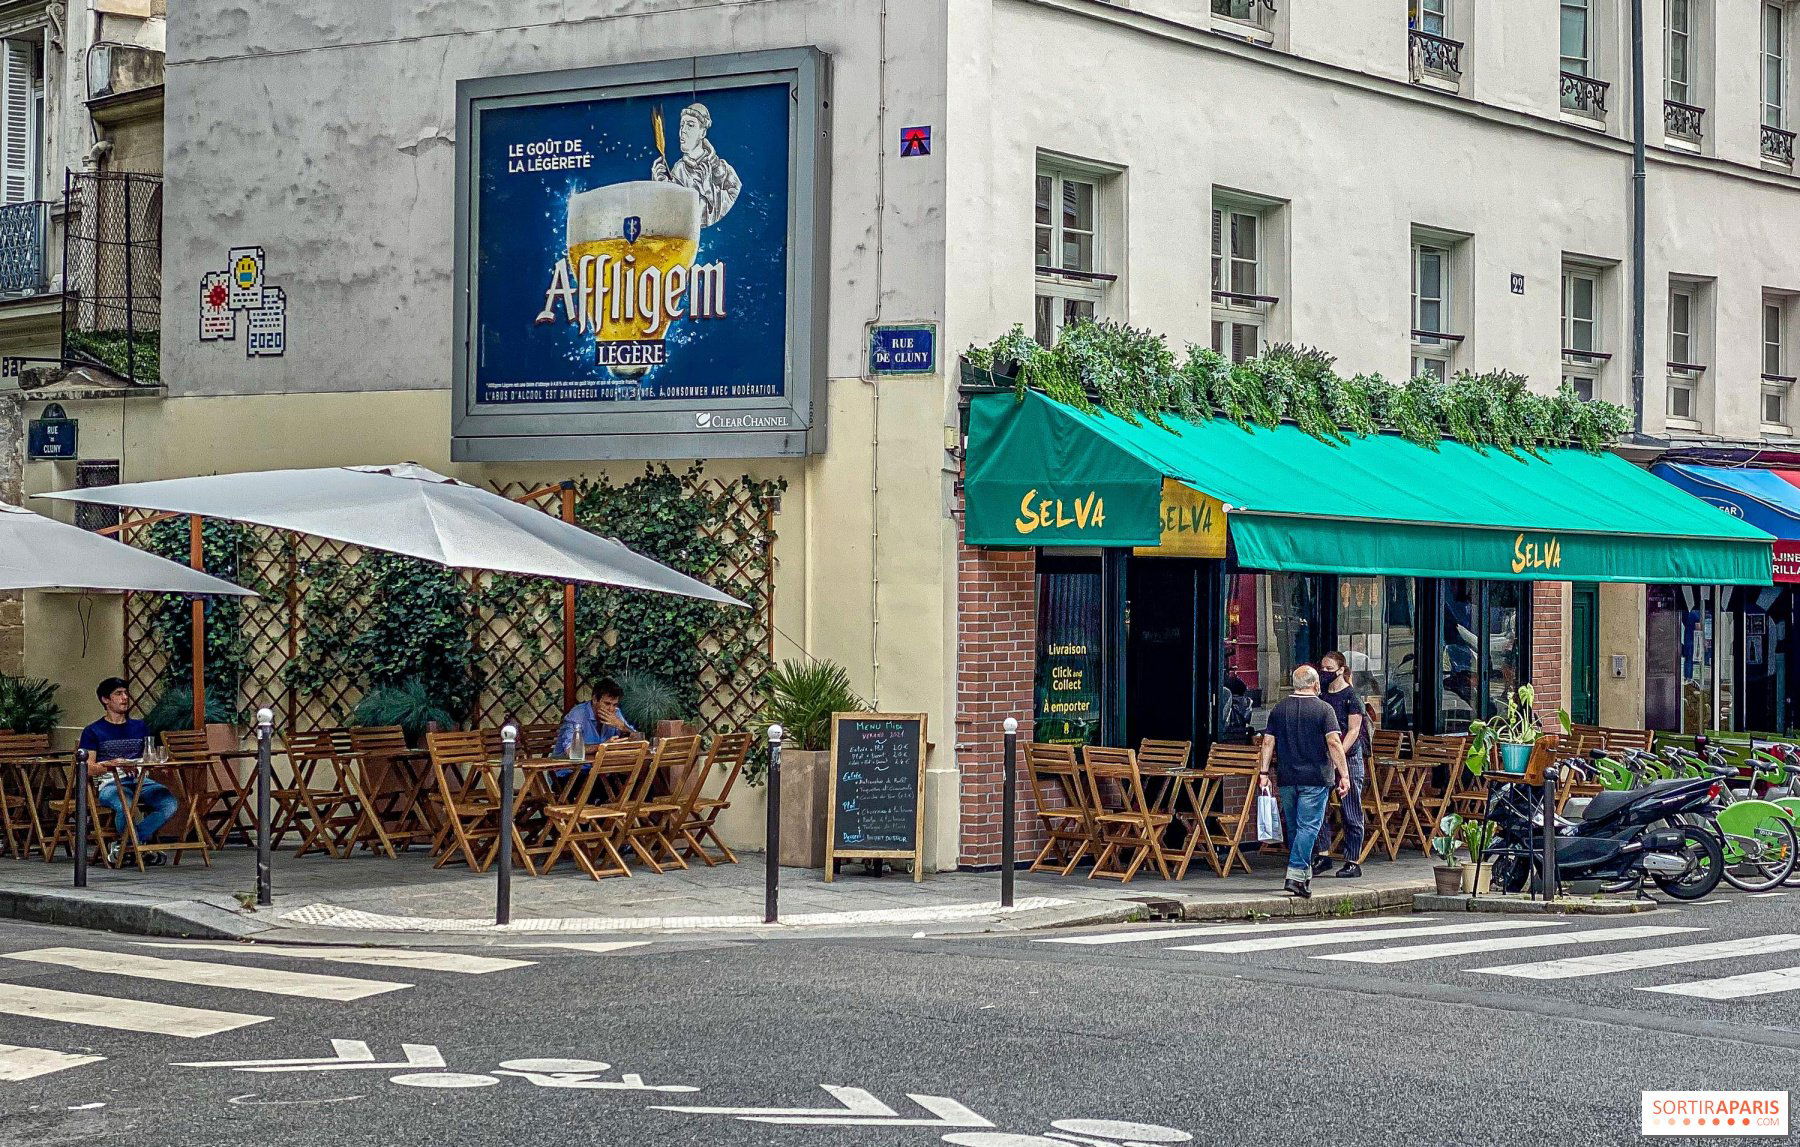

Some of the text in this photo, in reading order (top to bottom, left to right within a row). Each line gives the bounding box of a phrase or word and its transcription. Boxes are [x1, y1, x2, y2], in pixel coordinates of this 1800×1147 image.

[509, 138, 582, 157] LE GOÛT DE
[508, 160, 525, 172] LA
[1512, 276, 1523, 294] 22
[535, 254, 726, 334] Affligem
[250, 332, 282, 348] 2020
[892, 338, 914, 348] RUE
[598, 341, 664, 365] LÉGÈRE
[876, 352, 928, 362] DE CLUNY
[546, 390, 558, 399] EST
[712, 386, 728, 396] AVEC
[47, 426, 58, 434] RUE
[44, 444, 61, 454] CLUNY
[1048, 643, 1086, 655] Livraison
[1052, 666, 1082, 678] Click and
[1052, 679, 1082, 690] Collect
[1044, 699, 1090, 714] À emporter
